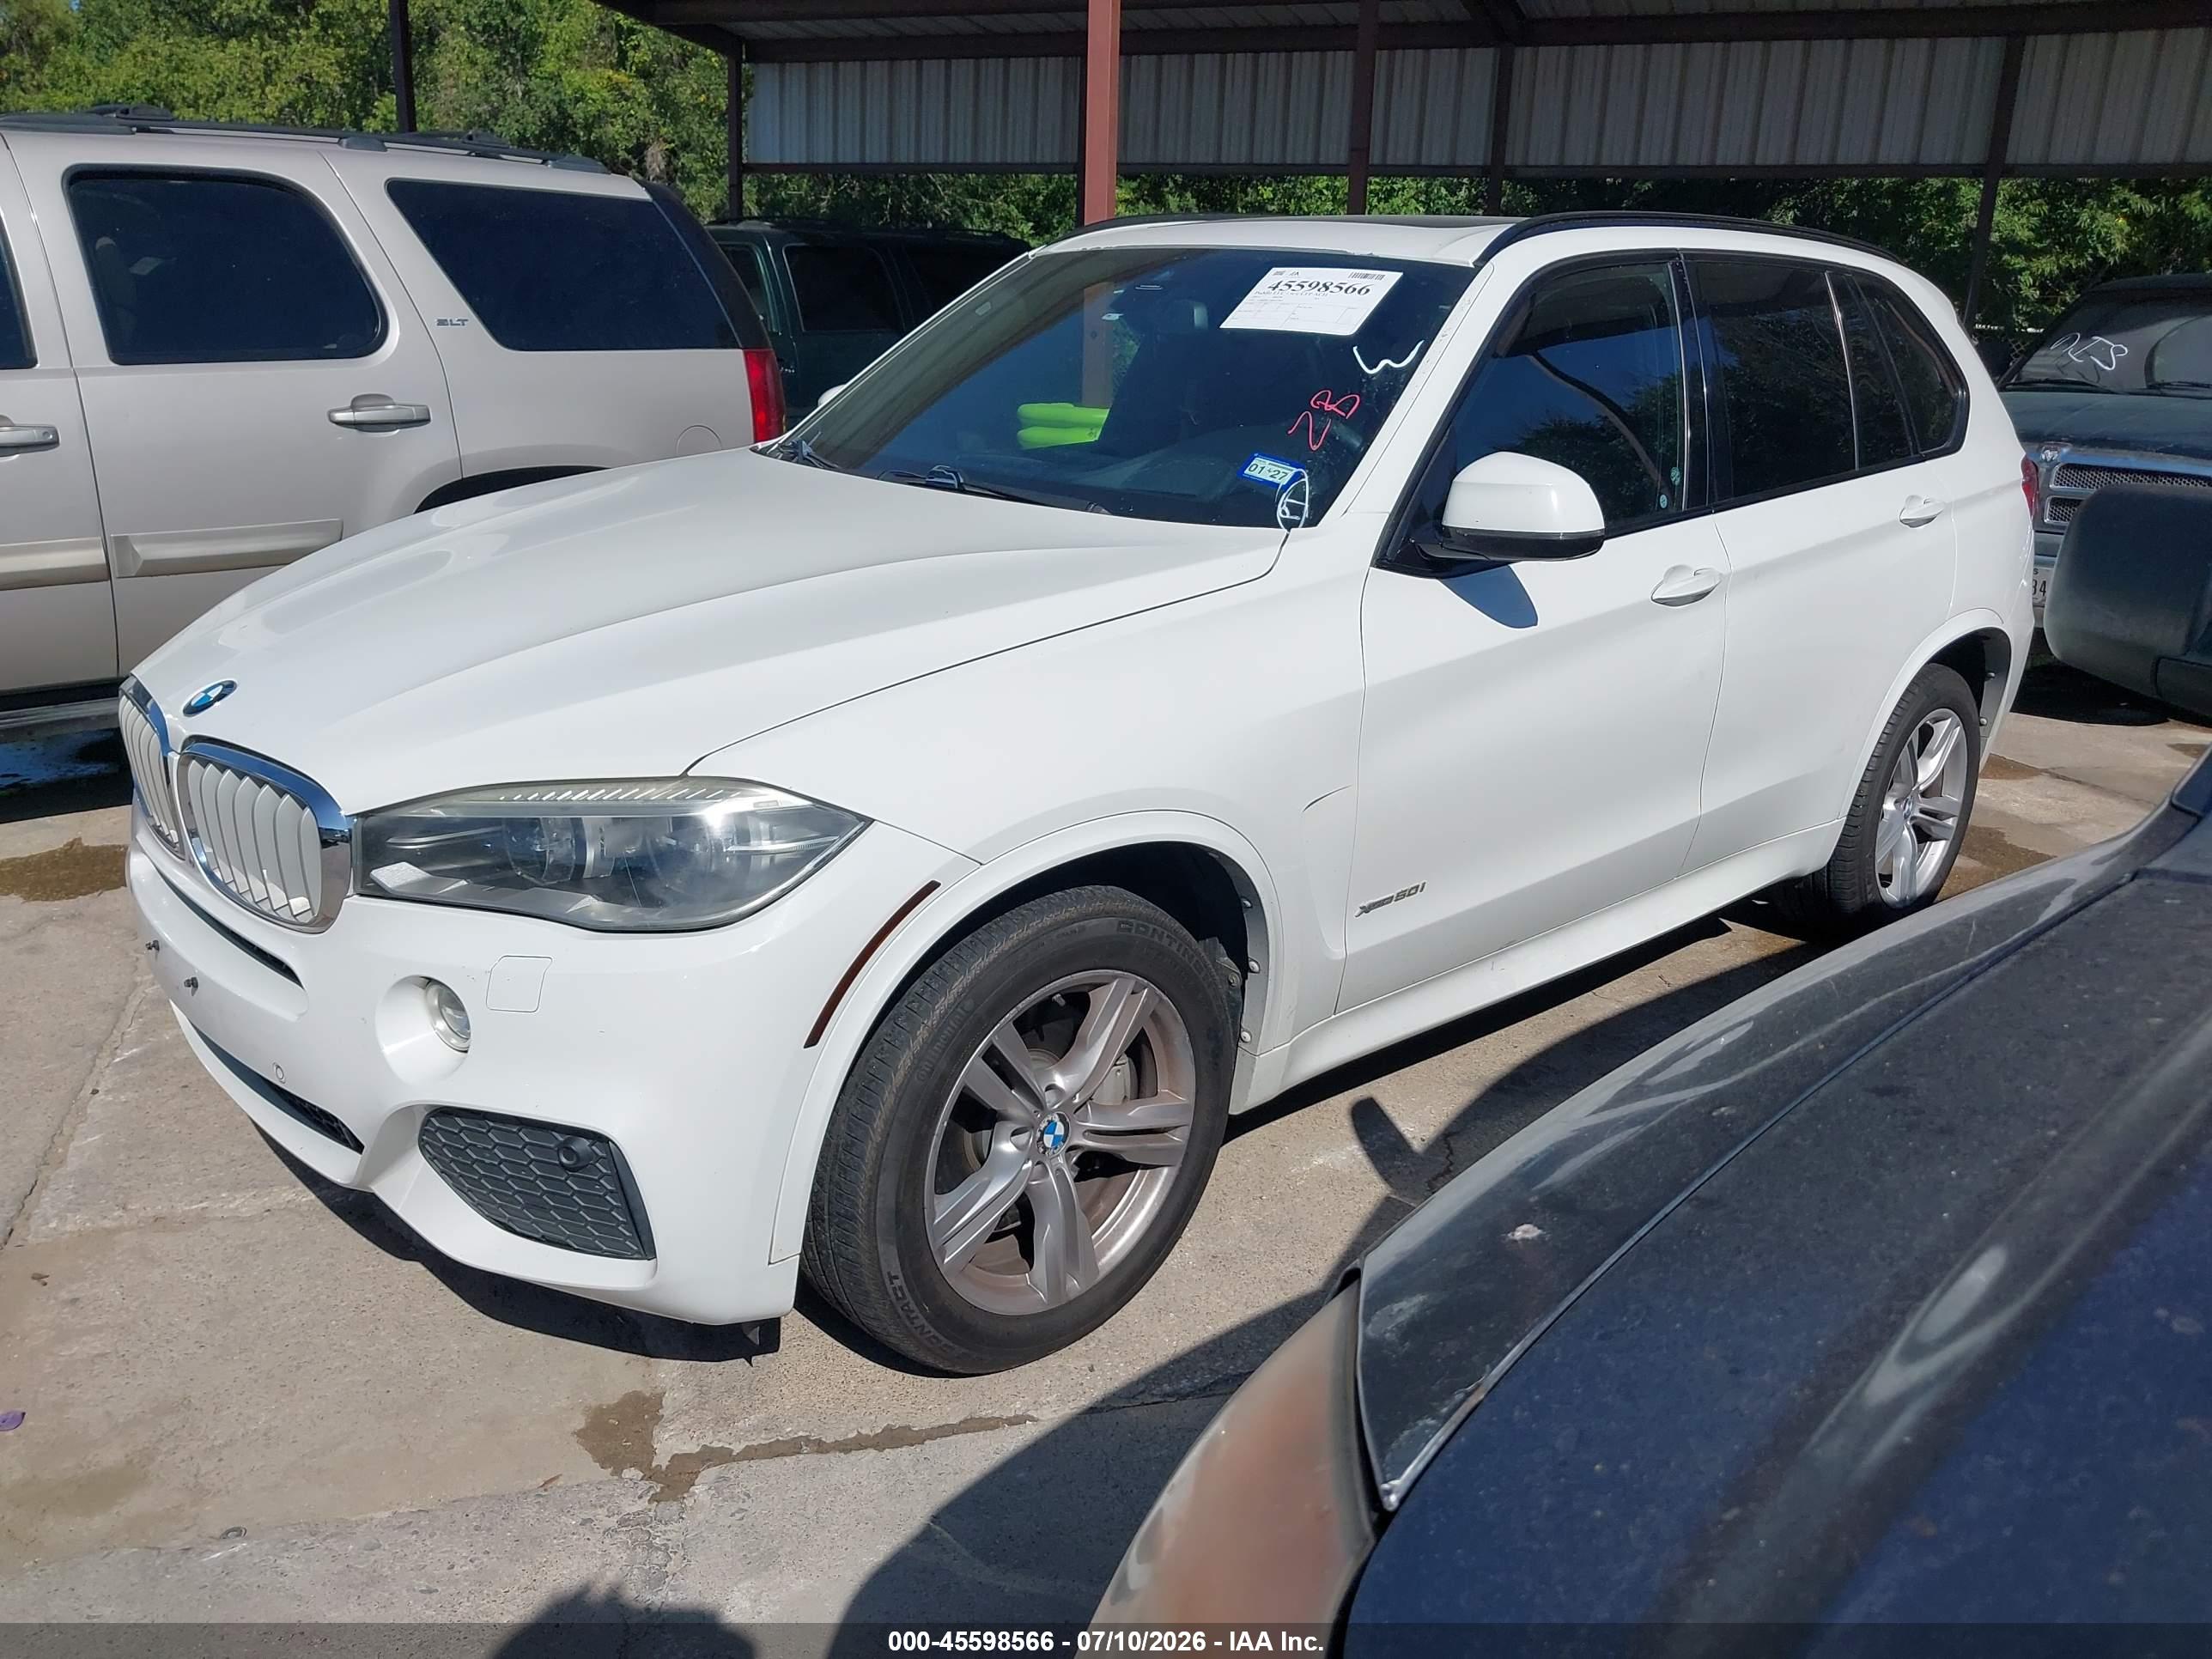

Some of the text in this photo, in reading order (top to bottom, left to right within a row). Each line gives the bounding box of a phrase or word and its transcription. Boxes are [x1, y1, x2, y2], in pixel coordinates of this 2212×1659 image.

[1267, 279, 1375, 296] 45598566
[1249, 464, 1266, 474] 01
[1269, 469, 1288, 480] 27
